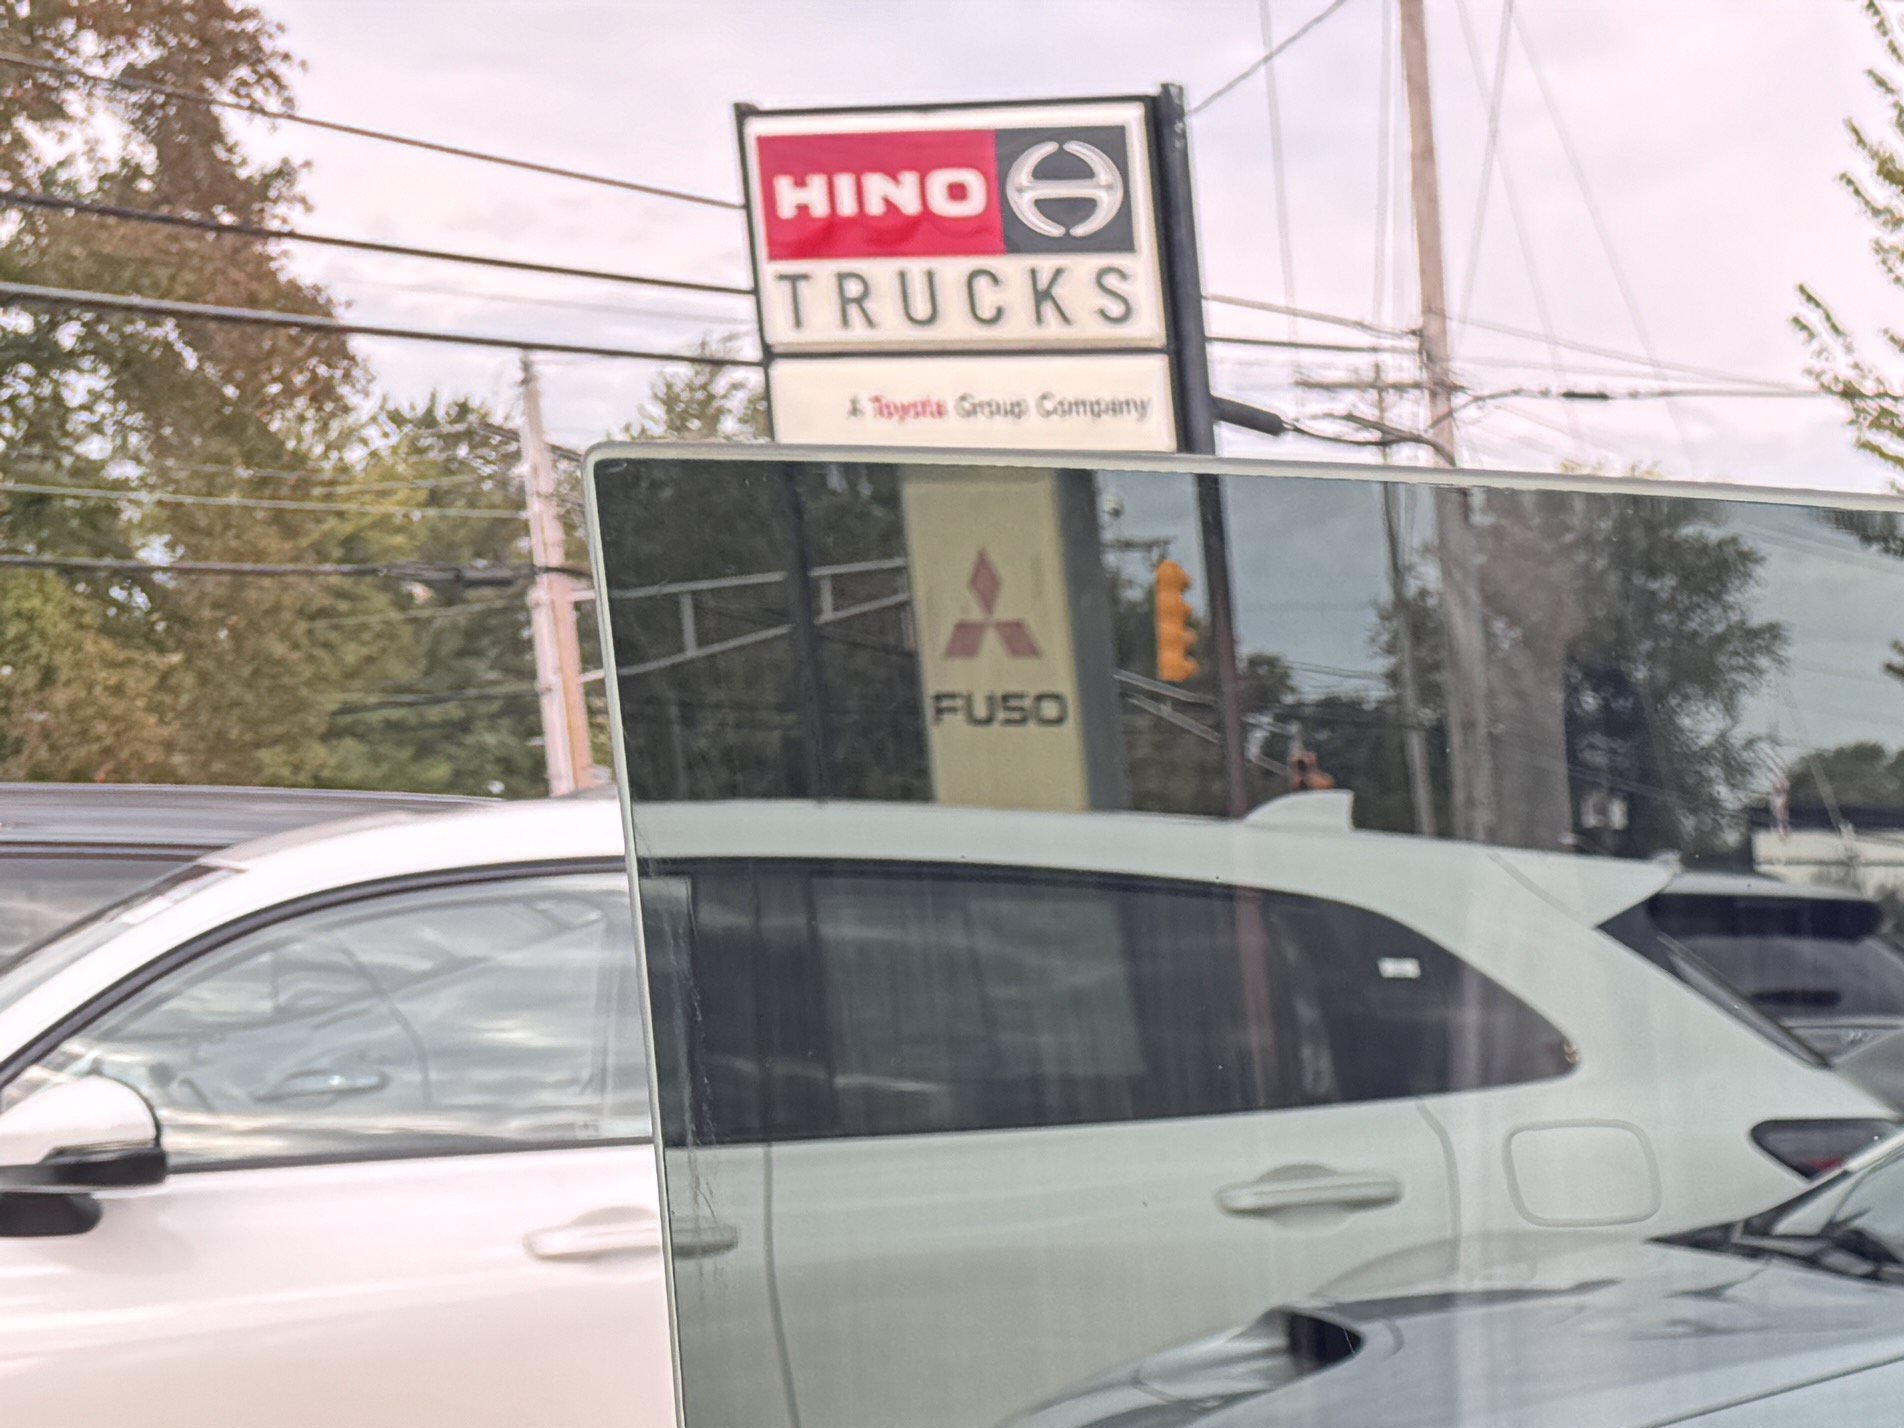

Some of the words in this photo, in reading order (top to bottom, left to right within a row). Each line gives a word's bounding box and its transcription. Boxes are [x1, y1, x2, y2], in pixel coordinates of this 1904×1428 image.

[774, 168, 987, 219] HINO
[775, 267, 1133, 330] TRUCKS
[869, 396, 947, 422] Toyota
[955, 393, 1027, 421] Group
[1035, 392, 1148, 421] Company
[932, 691, 1067, 727] FUSO
